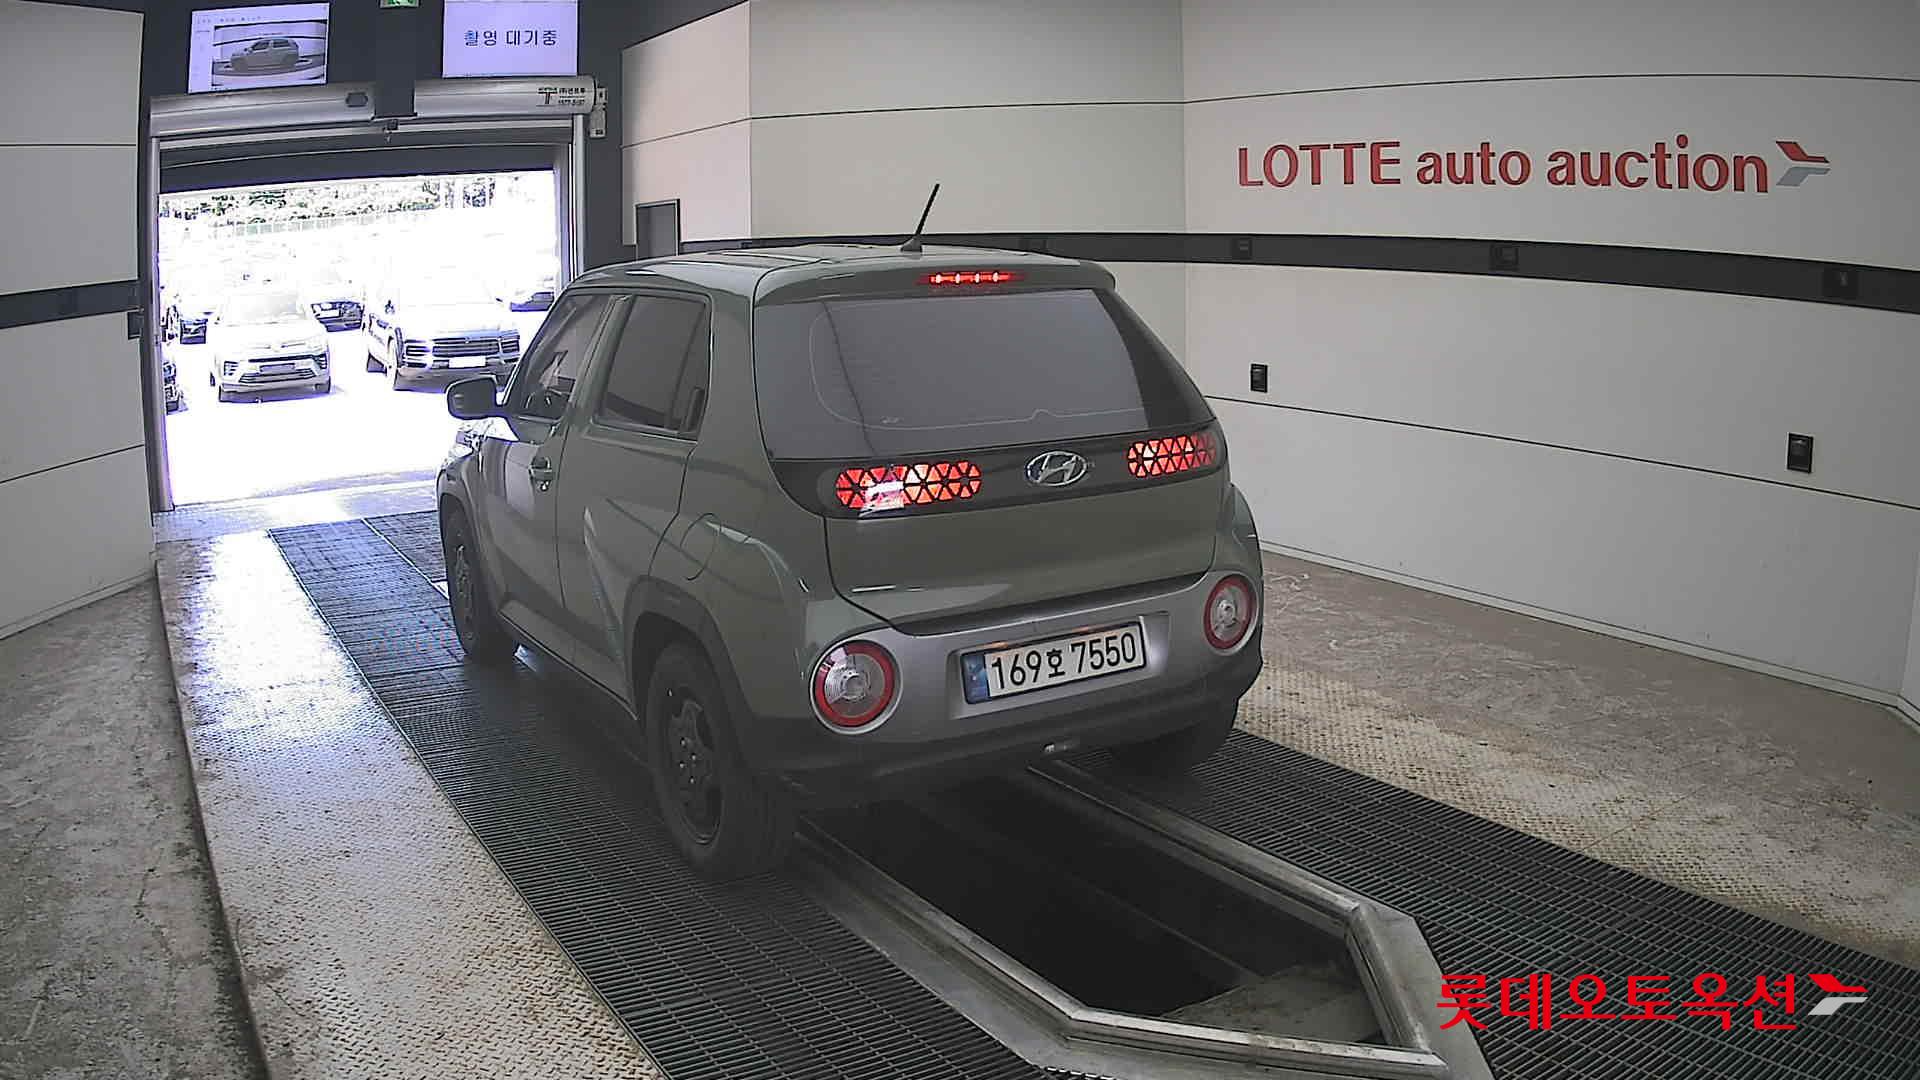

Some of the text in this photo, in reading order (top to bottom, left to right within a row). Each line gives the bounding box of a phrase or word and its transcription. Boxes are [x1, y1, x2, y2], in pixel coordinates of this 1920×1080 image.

[464, 29, 557, 47] 촬영 대기중
[1238, 135, 1770, 193] LOTTE auto auction
[991, 632, 1137, 690] 169호 7550
